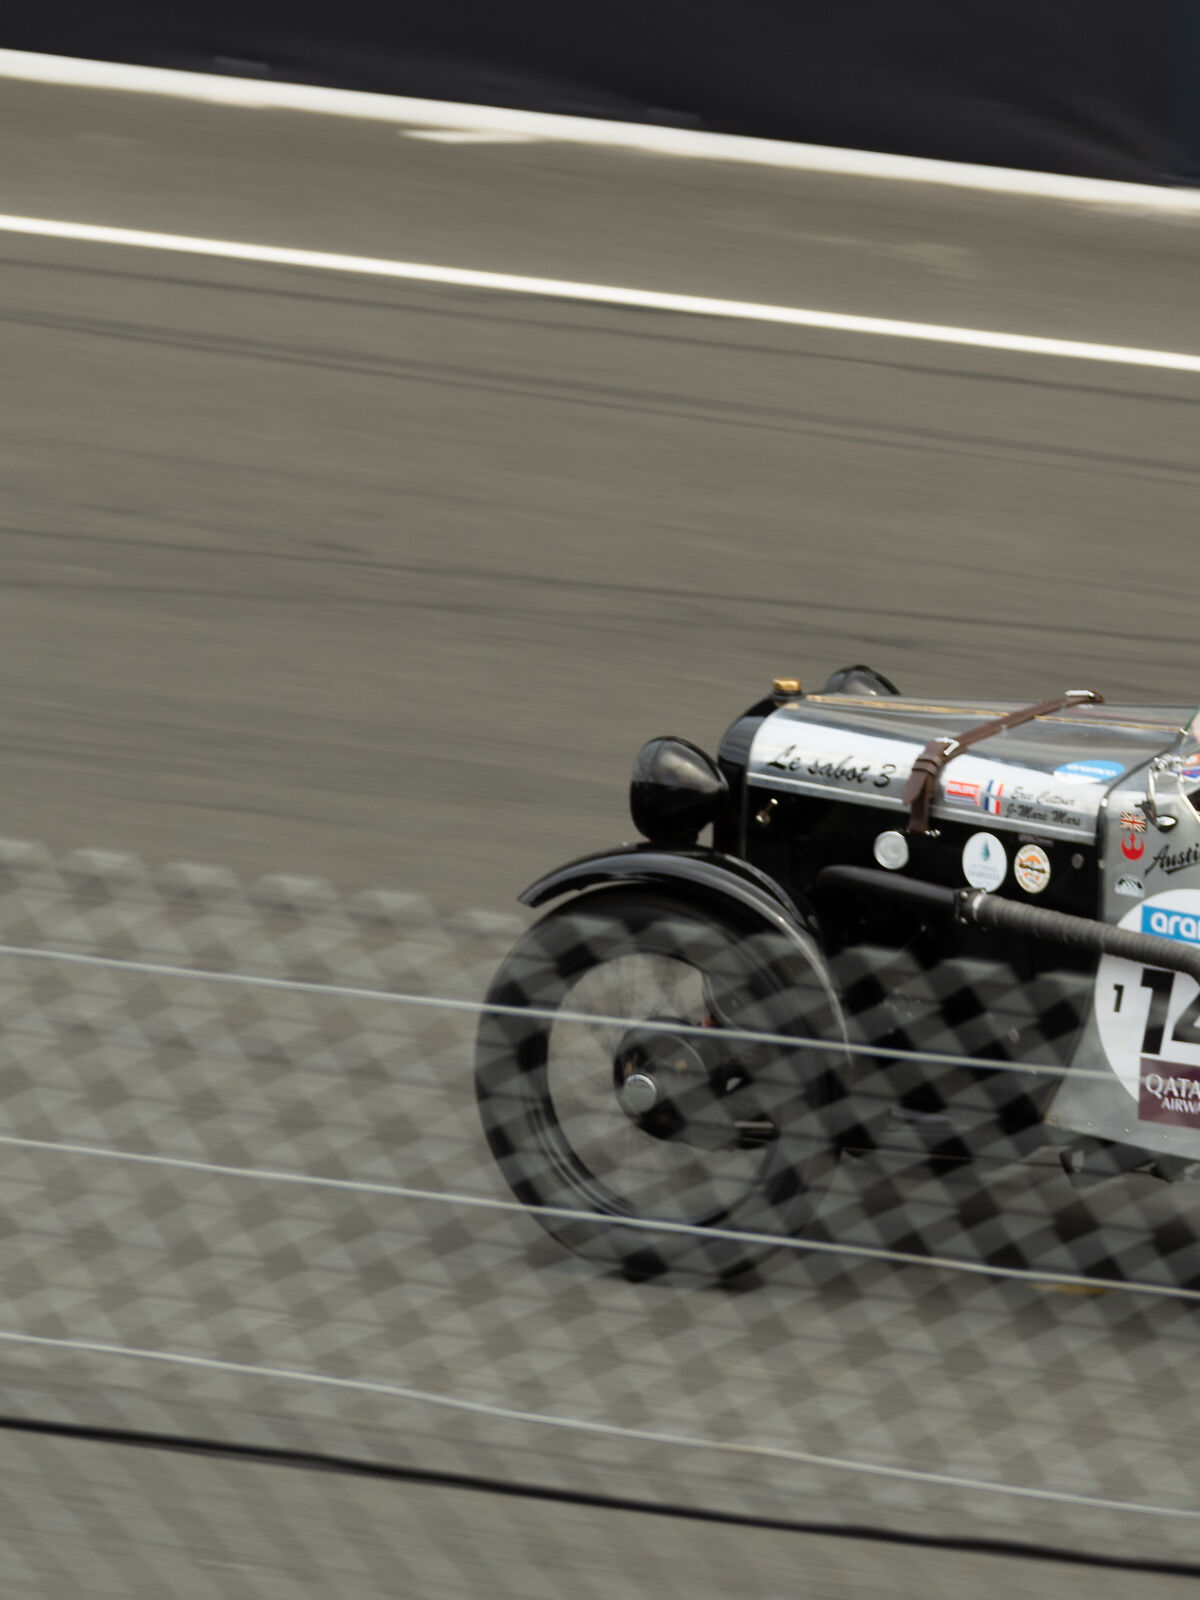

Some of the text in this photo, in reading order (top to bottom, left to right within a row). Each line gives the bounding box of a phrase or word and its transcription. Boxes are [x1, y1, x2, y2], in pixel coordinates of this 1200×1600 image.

[766, 744, 801, 772] Le
[873, 763, 897, 788] 3
[1112, 983, 1124, 1013] 1
